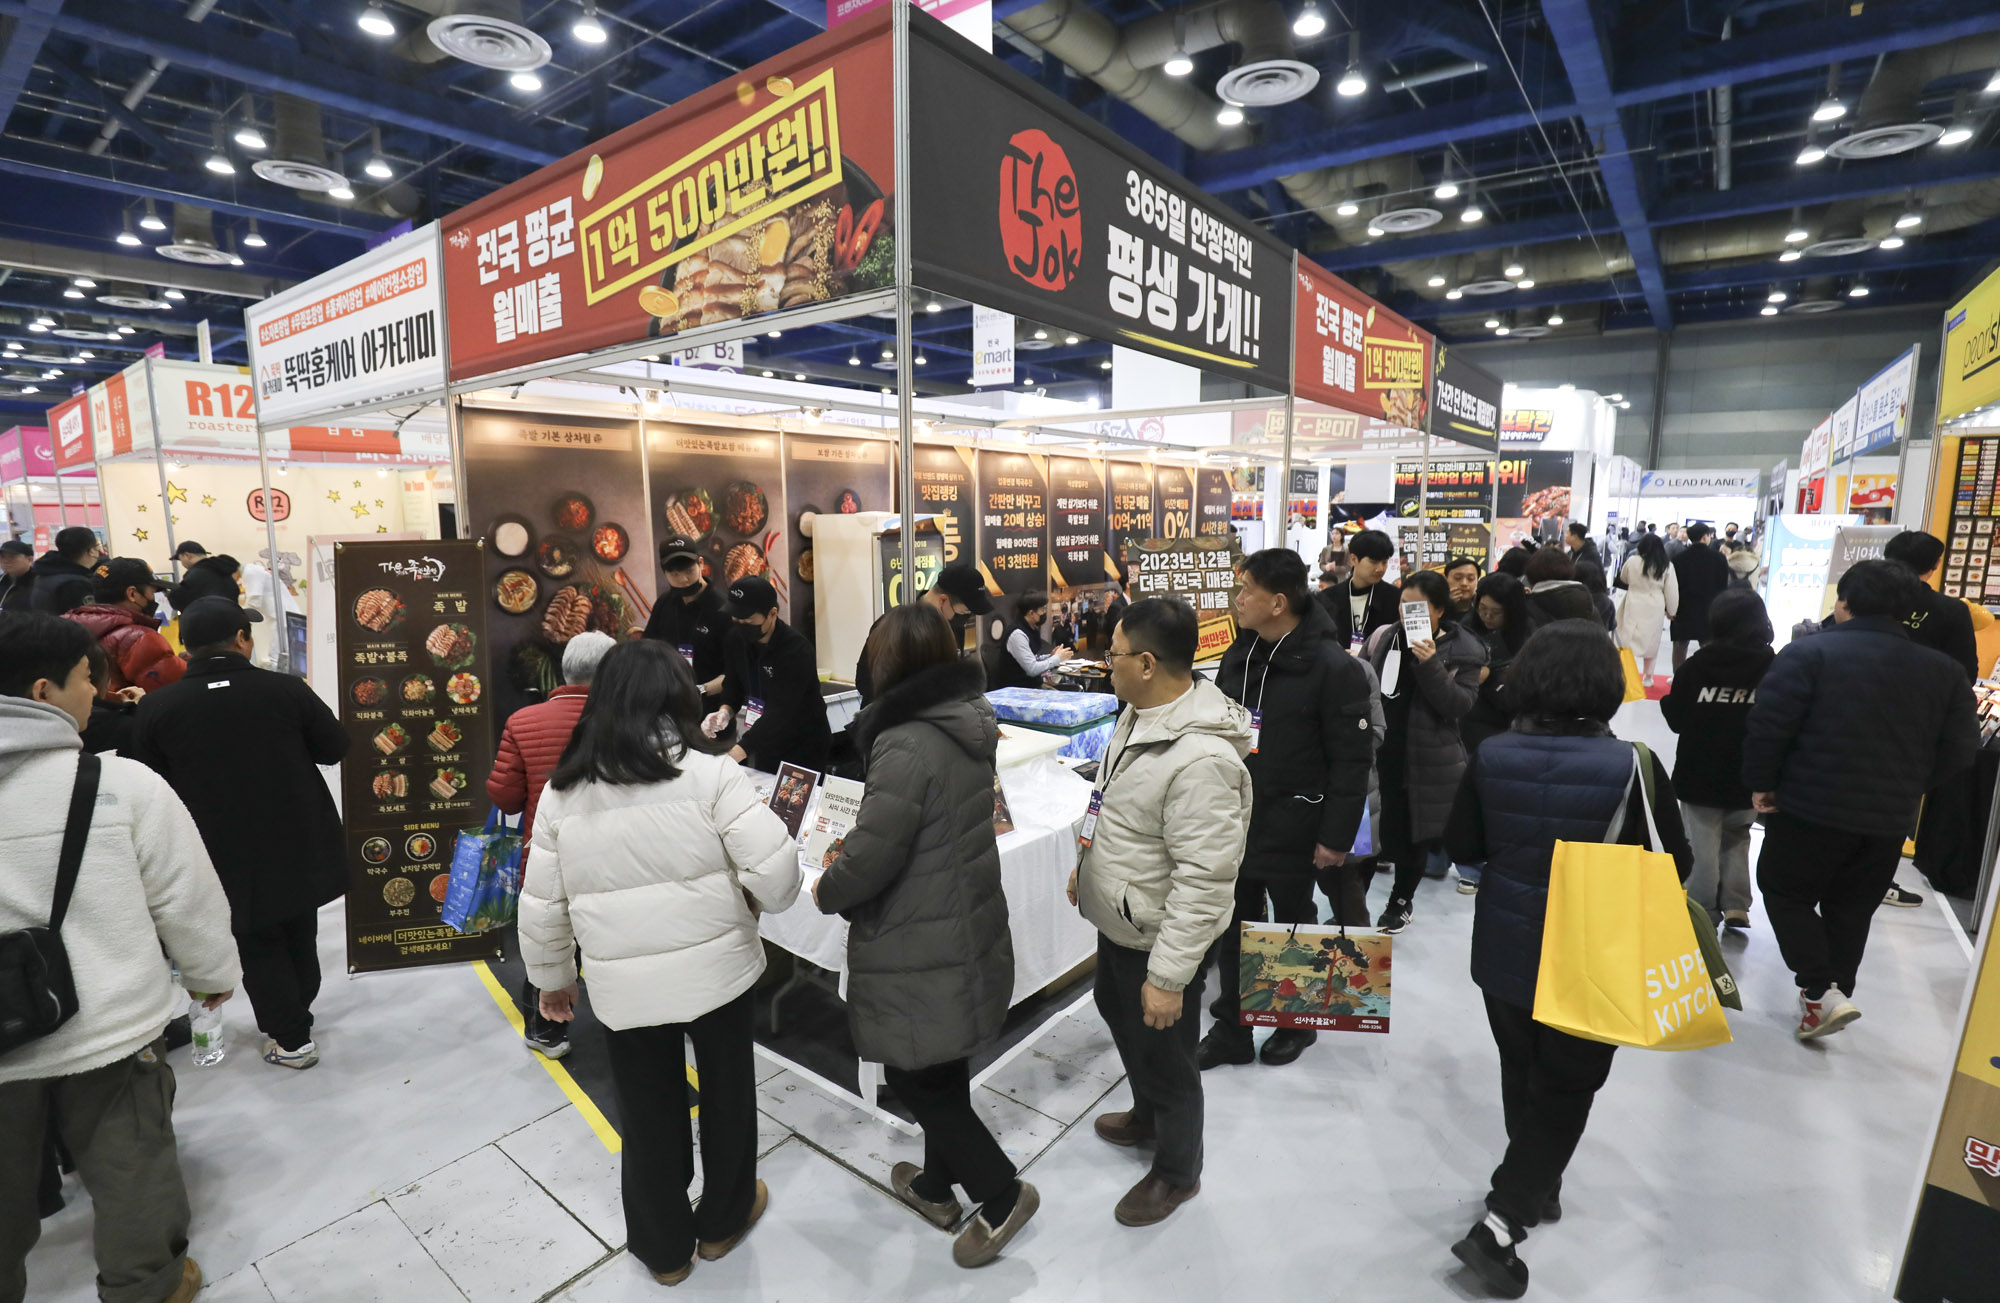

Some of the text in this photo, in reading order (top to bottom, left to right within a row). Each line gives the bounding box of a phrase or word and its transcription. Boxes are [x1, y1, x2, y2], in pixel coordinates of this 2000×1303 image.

[1001, 143, 1080, 219] The
[588, 98, 827, 282] 1억 500만원!
[1125, 170, 1253, 280] 365일 안정적인
[476, 195, 575, 287] 전국 평균
[1013, 208, 1079, 287] Jok
[365, 261, 424, 303] #에어컨청소창업
[1106, 223, 1261, 360] 평생 가게!!
[492, 271, 564, 344] 월매출
[1316, 292, 1364, 352] 전국 평균
[285, 310, 437, 393] 뚝딱홈케어 아카데미
[714, 341, 735, 360] B2
[975, 347, 1012, 365] emart
[1322, 345, 1356, 393] 월매출
[1366, 347, 1423, 382] 1억 500만원!
[185, 380, 256, 419] R12
[541, 431, 561, 443] 기본
[564, 432, 592, 444] 상차림
[675, 437, 736, 452] 더맛있는족발보쌈
[1486, 460, 1527, 484] 1위!
[1668, 478, 1746, 487] LEAD PLANET
[921, 485, 958, 501] 맛집랭킹
[989, 493, 1041, 509] 간판만 바꾸고
[1114, 495, 1149, 510] 연 평균 매출
[984, 512, 1046, 528] 월매출 20배 상승!
[1067, 514, 1089, 525] 족발보쌈
[1164, 511, 1190, 538] 0%
[1201, 521, 1216, 535] 4시간
[996, 537, 1039, 549] 월매출 900만원
[378, 561, 403, 573] The
[992, 553, 1039, 570] 1억 3천만원
[1139, 551, 1231, 571] 2023년 12월
[1139, 571, 1235, 592] 더족 전국 매장
[433, 600, 468, 613] 족 발
[1200, 592, 1229, 610] 매출
[354, 651, 408, 664] 족발+불족
[828, 803, 840, 812] 시식
[839, 806, 851, 815] 시간
[403, 822, 440, 831] SIDE MENU
[367, 867, 388, 875] 막국수
[400, 863, 442, 872] 날치알 주먹밥
[358, 933, 392, 944] 네이버에
[400, 942, 452, 955] 검색해주세요!
